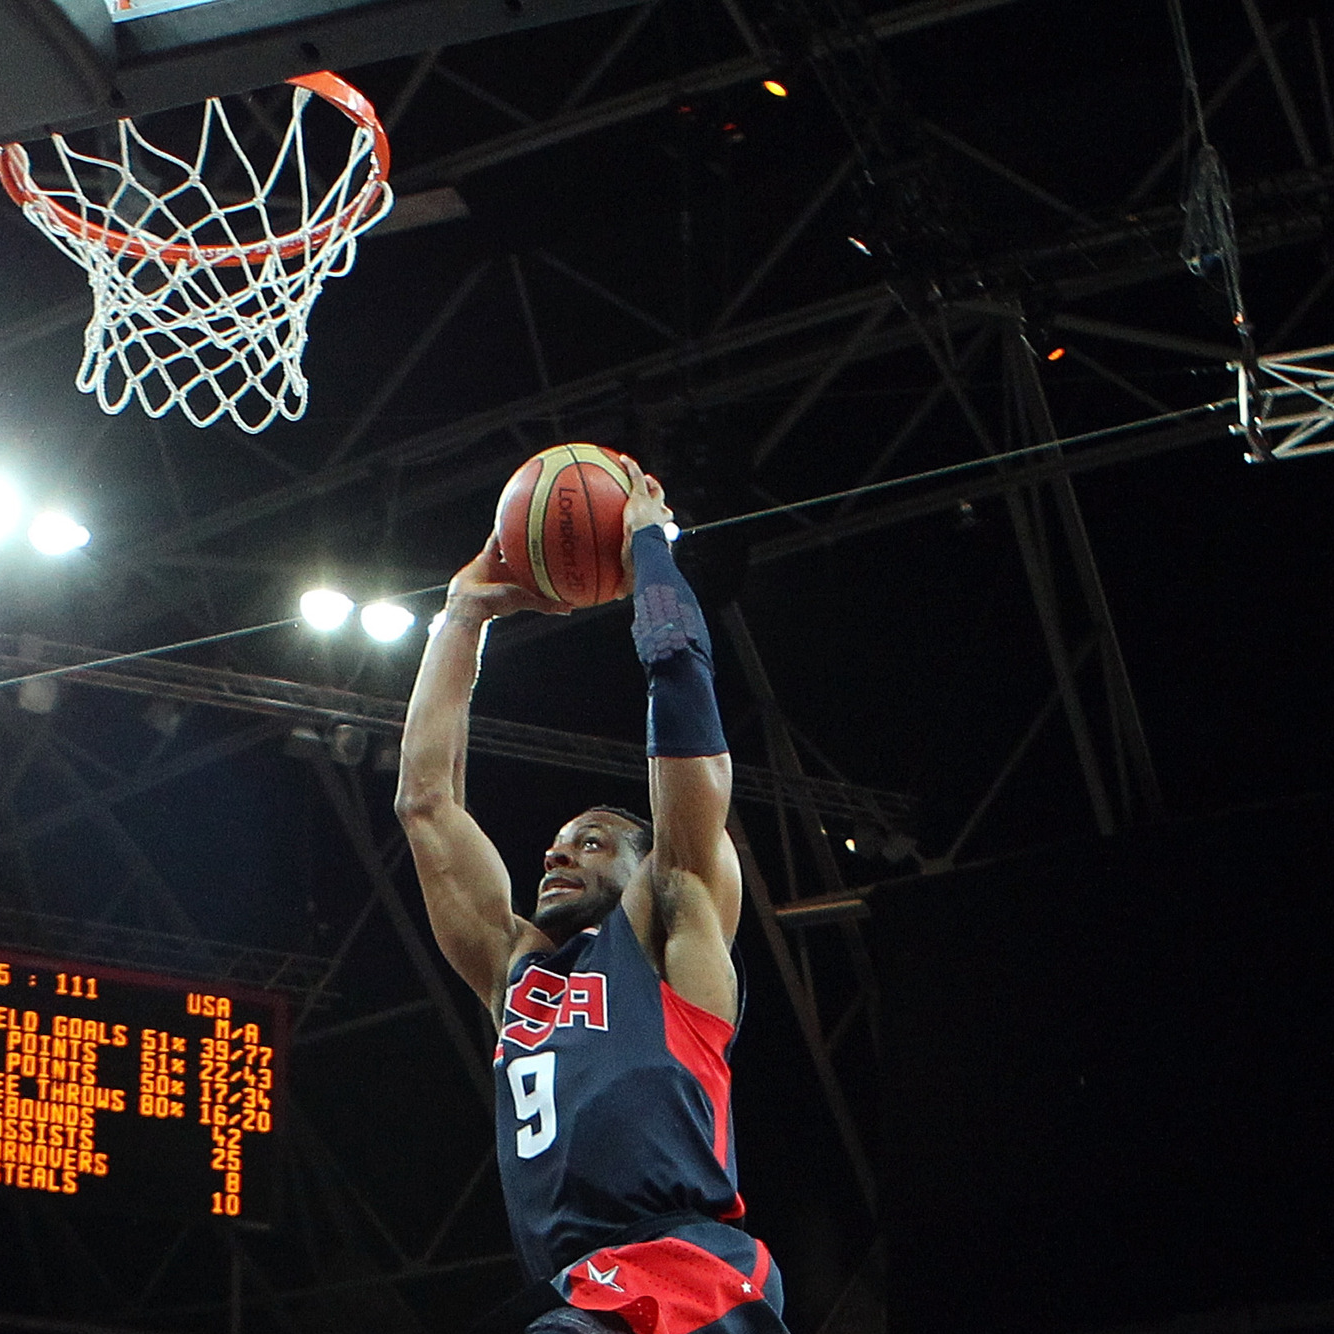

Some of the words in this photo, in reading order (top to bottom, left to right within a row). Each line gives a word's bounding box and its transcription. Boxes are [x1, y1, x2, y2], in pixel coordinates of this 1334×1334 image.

[54, 972, 98, 999] 111
[186, 992, 232, 1018] USA
[495, 965, 609, 1066] SA
[52, 1015, 128, 1047] GOALS
[141, 1028, 187, 1053] 51%
[199, 1037, 274, 1067] 39/77
[215, 1018, 260, 1045] M/A
[6, 1030, 97, 1063] POINTS
[140, 1050, 186, 1075] 51%
[198, 1060, 273, 1090] 22/43
[4, 1051, 97, 1085] POINTS
[139, 1071, 185, 1097] 50%
[198, 1081, 272, 1111] 17/34
[35, 1079, 126, 1112] THROWS
[138, 1093, 185, 1118] 80%
[198, 1103, 272, 1133] 16/20
[506, 1050, 558, 1160] 9
[212, 1126, 243, 1151] 42
[210, 1147, 243, 1173] 25
[225, 1171, 242, 1194] 8
[210, 1192, 241, 1216] 10
